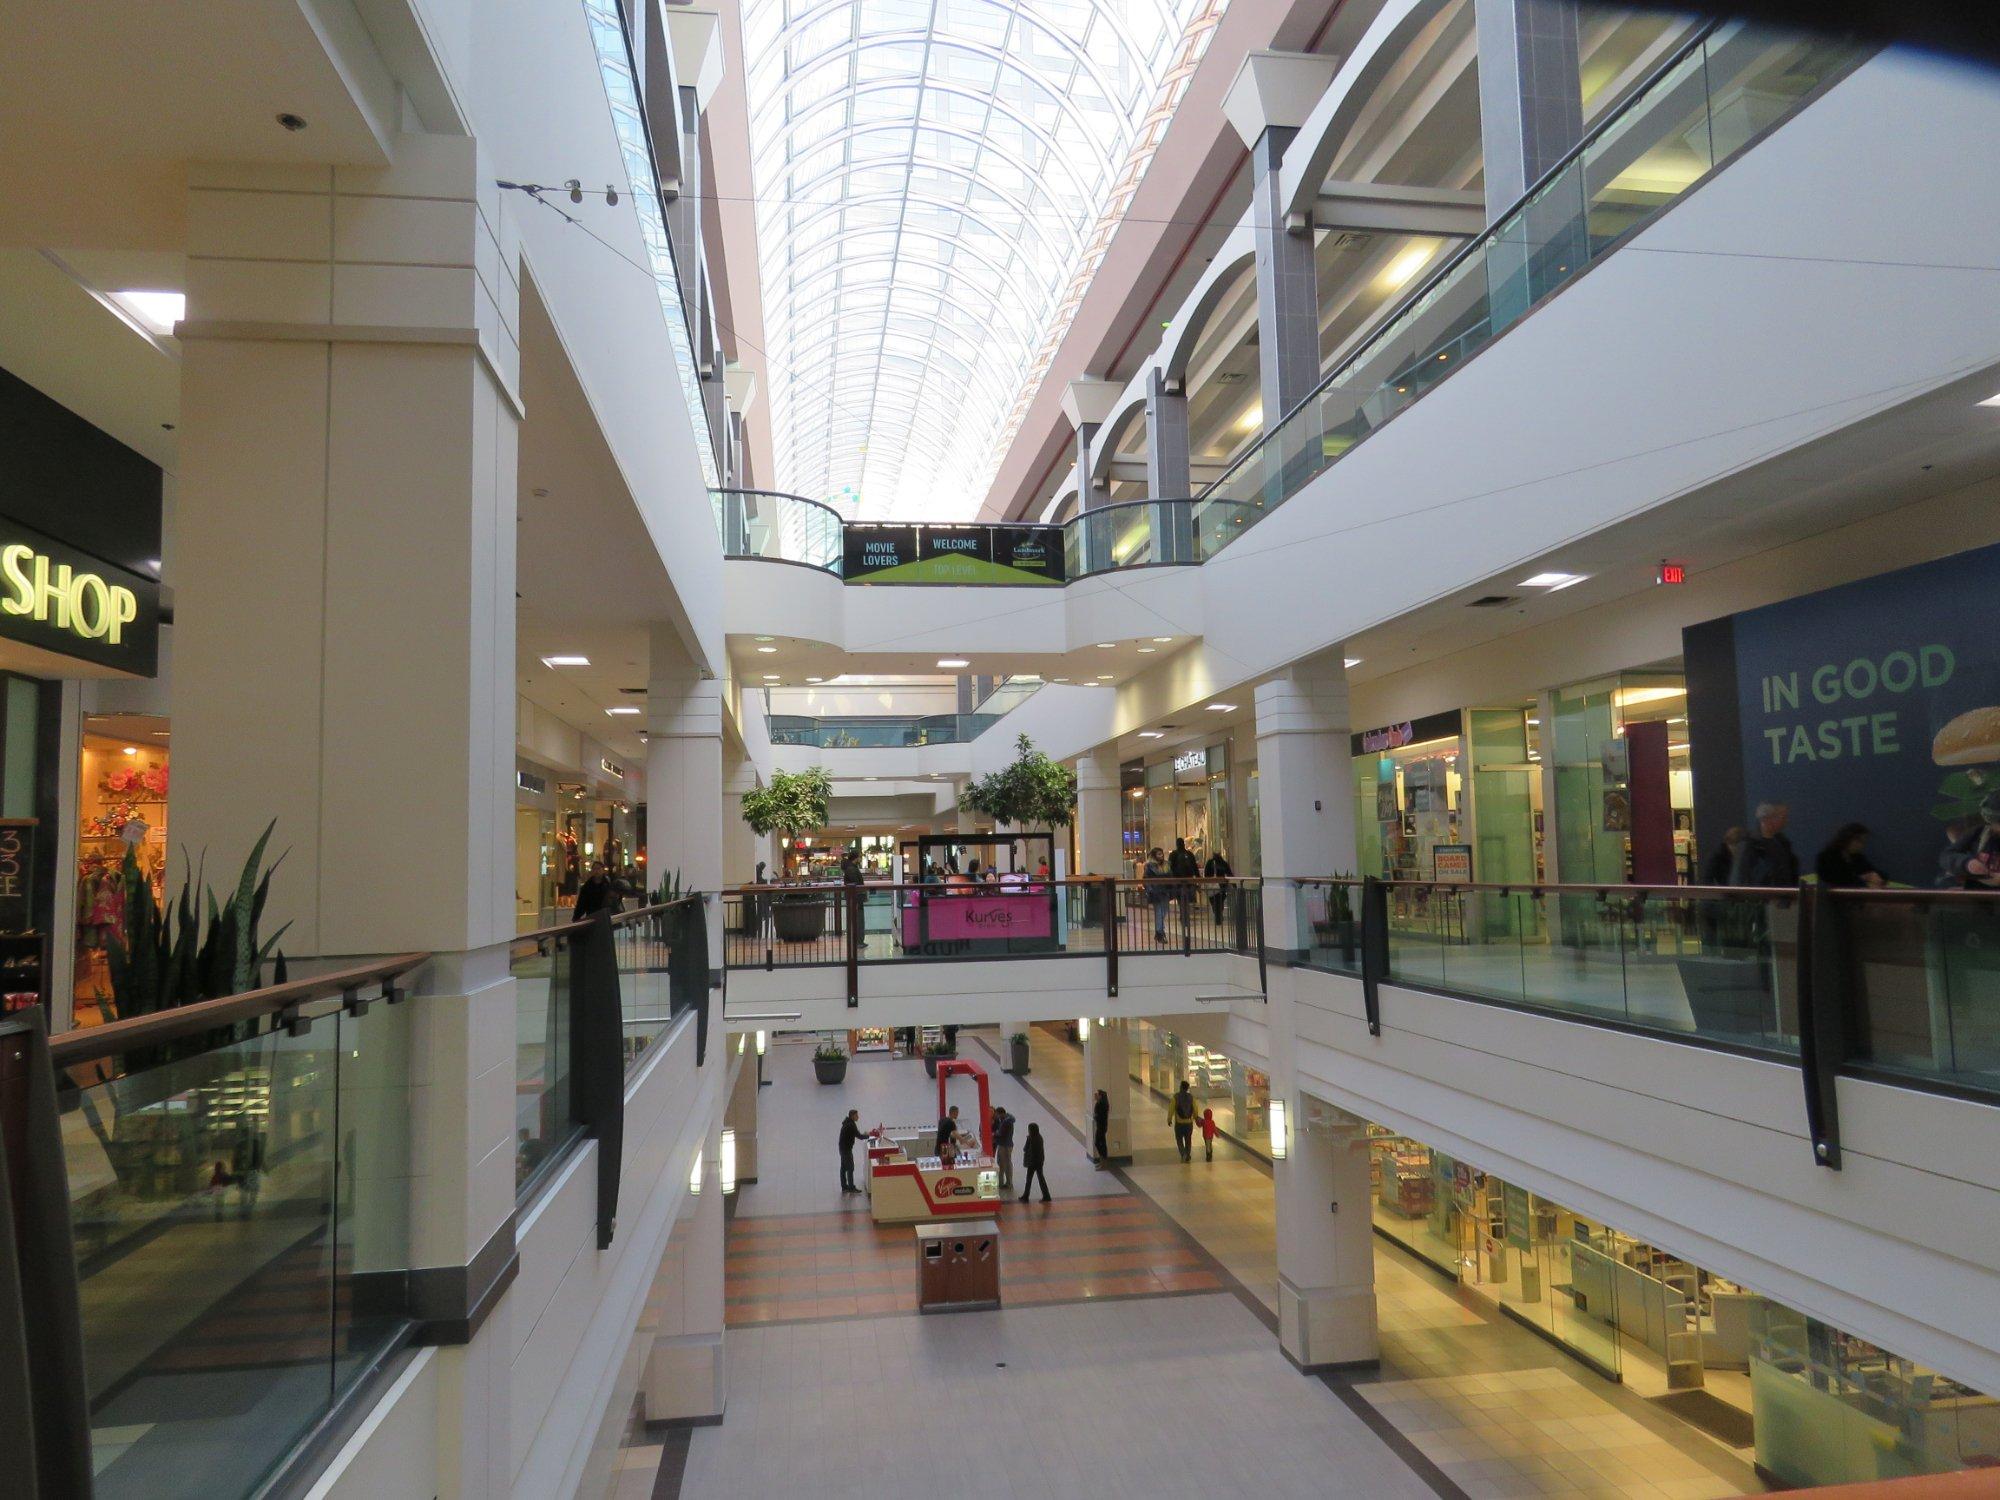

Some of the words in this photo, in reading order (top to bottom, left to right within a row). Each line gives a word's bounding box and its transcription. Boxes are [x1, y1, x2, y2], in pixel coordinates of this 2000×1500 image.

[866, 543, 895, 554] MOVIE
[933, 539, 977, 550] WELCOME
[863, 555, 899, 566] LOVERS
[1664, 567, 1682, 583] EXIT
[1, 544, 137, 645] SHOP
[1762, 671, 1800, 713] IN
[1812, 644, 1956, 704] GOOD
[1763, 711, 1901, 765] TASTE
[1437, 854, 1467, 862] BOARD
[1437, 861, 1468, 869] GAMES
[965, 908, 1013, 923] Kurves
